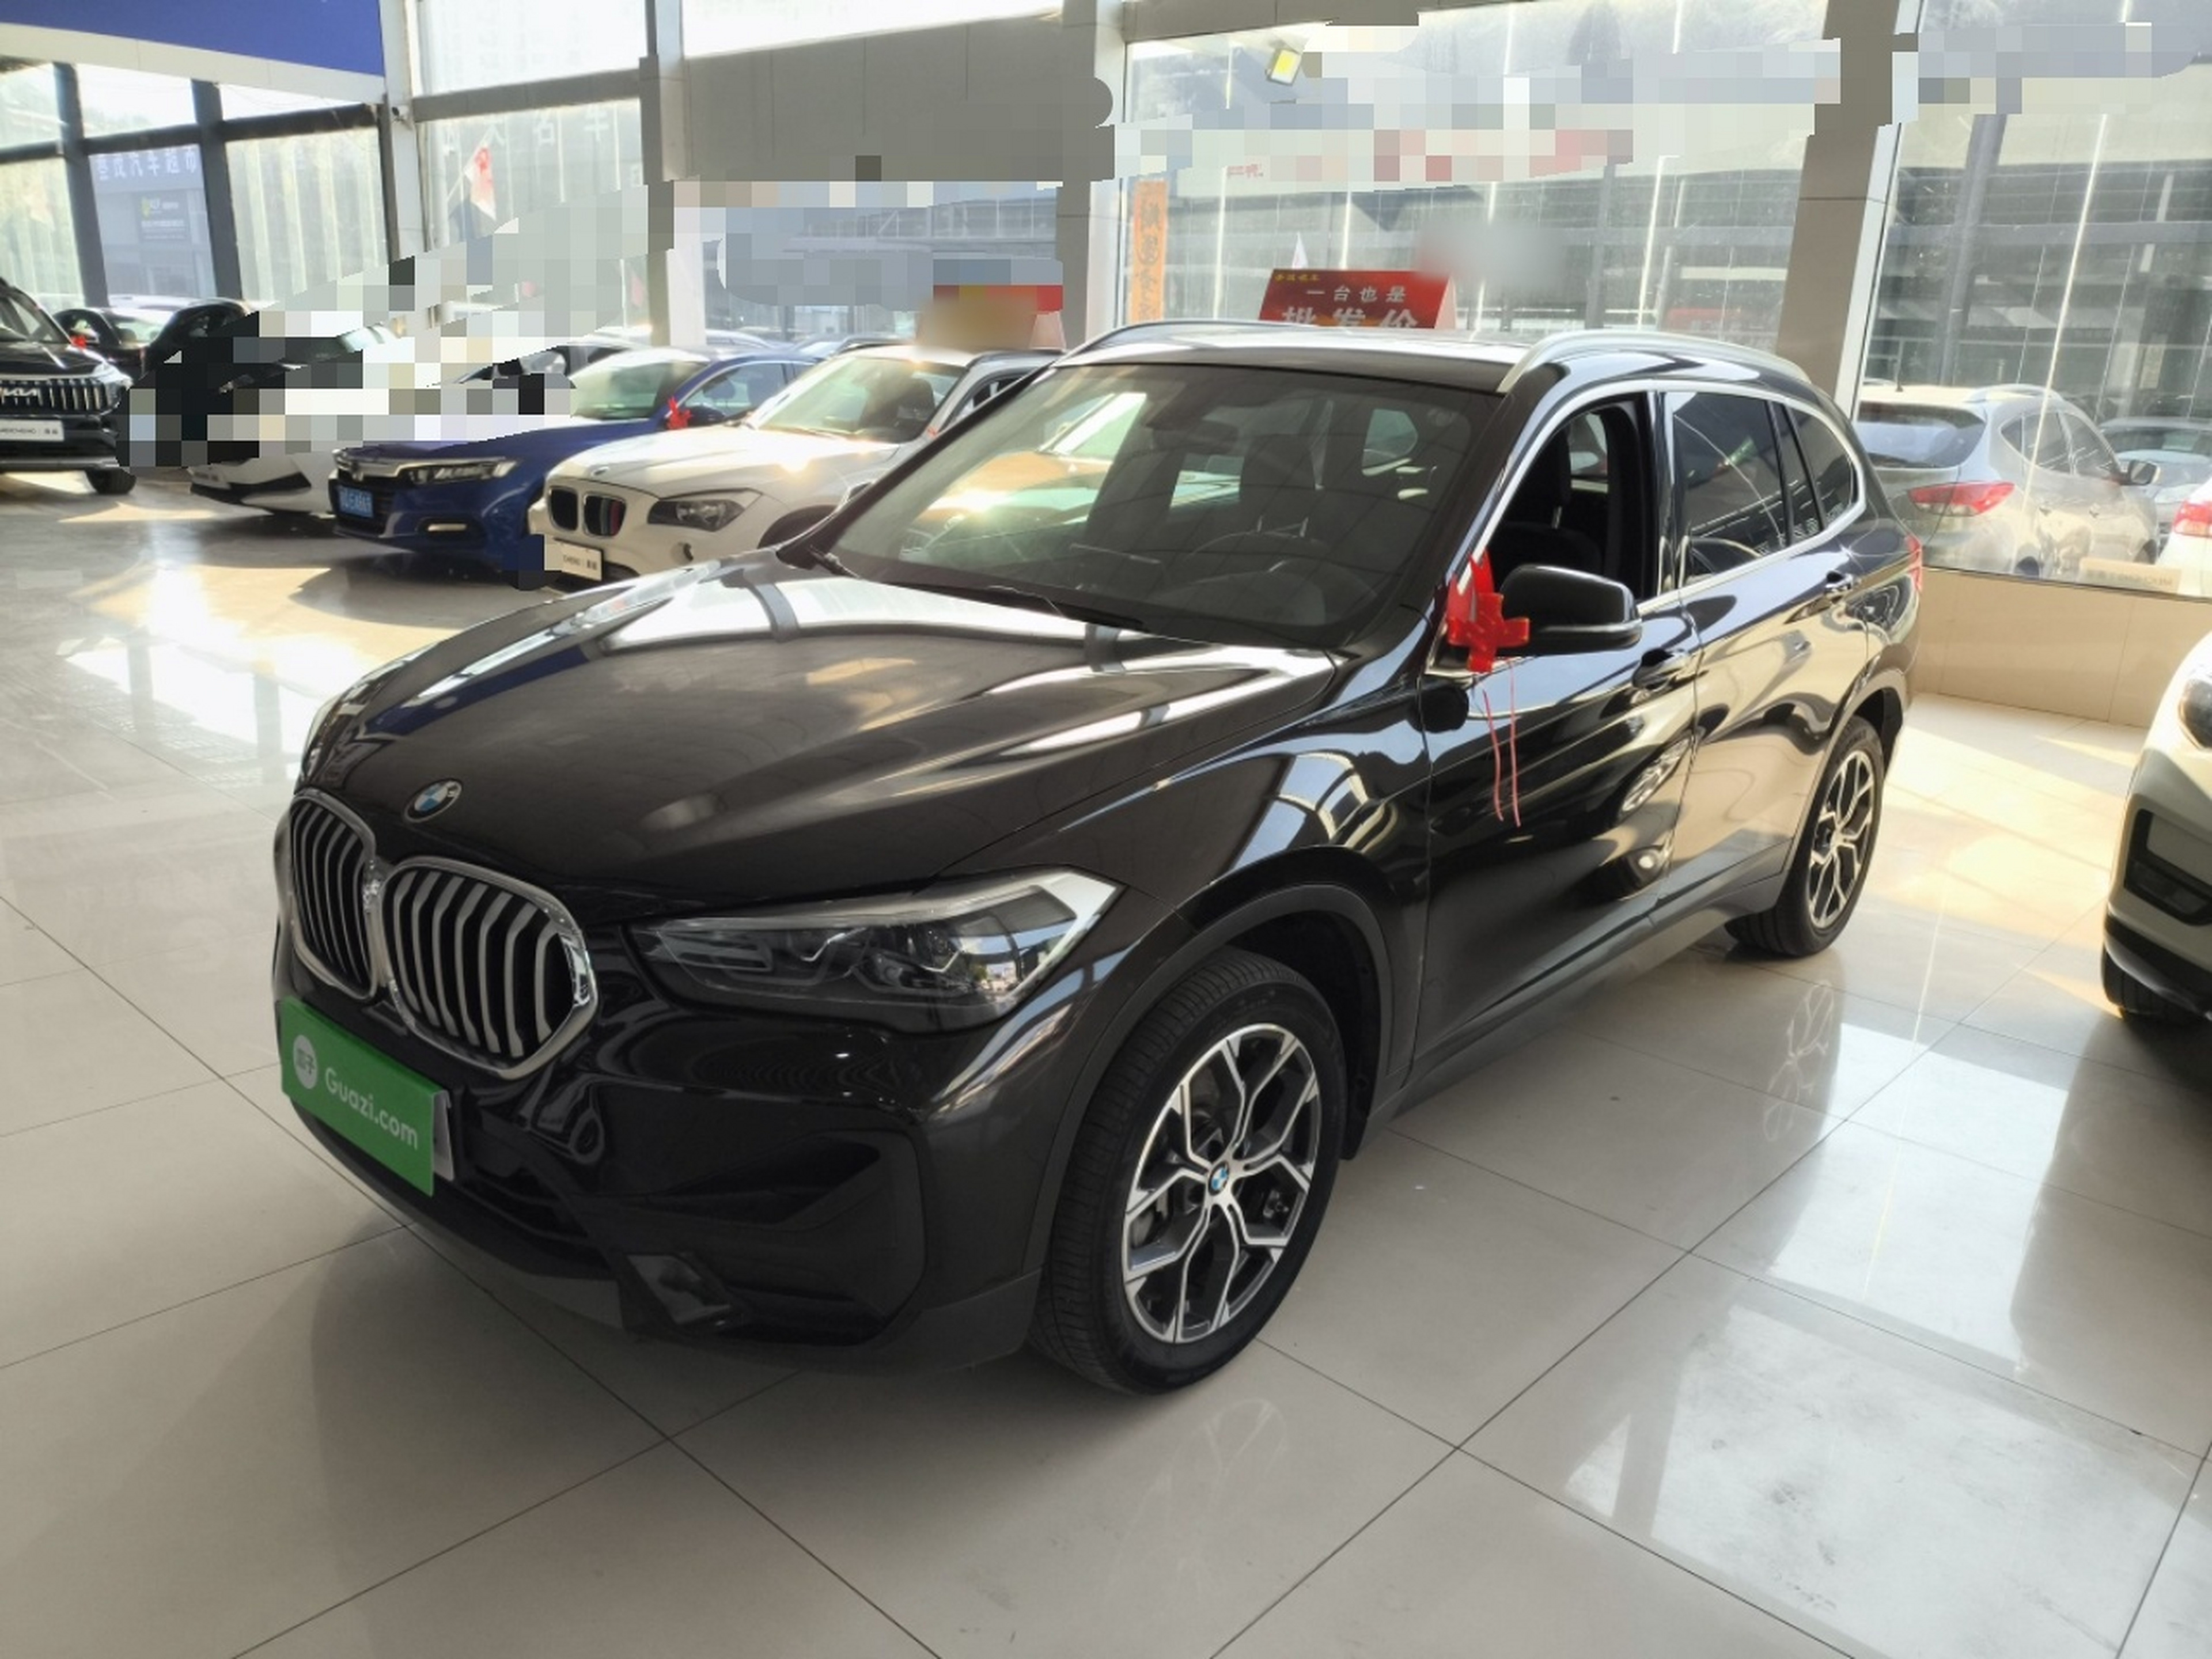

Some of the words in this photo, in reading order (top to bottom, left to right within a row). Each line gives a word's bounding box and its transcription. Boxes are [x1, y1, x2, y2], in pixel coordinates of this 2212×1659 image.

[1306, 285, 1406, 302] 一台也是
[325, 1067, 418, 1150] Guazi.com
